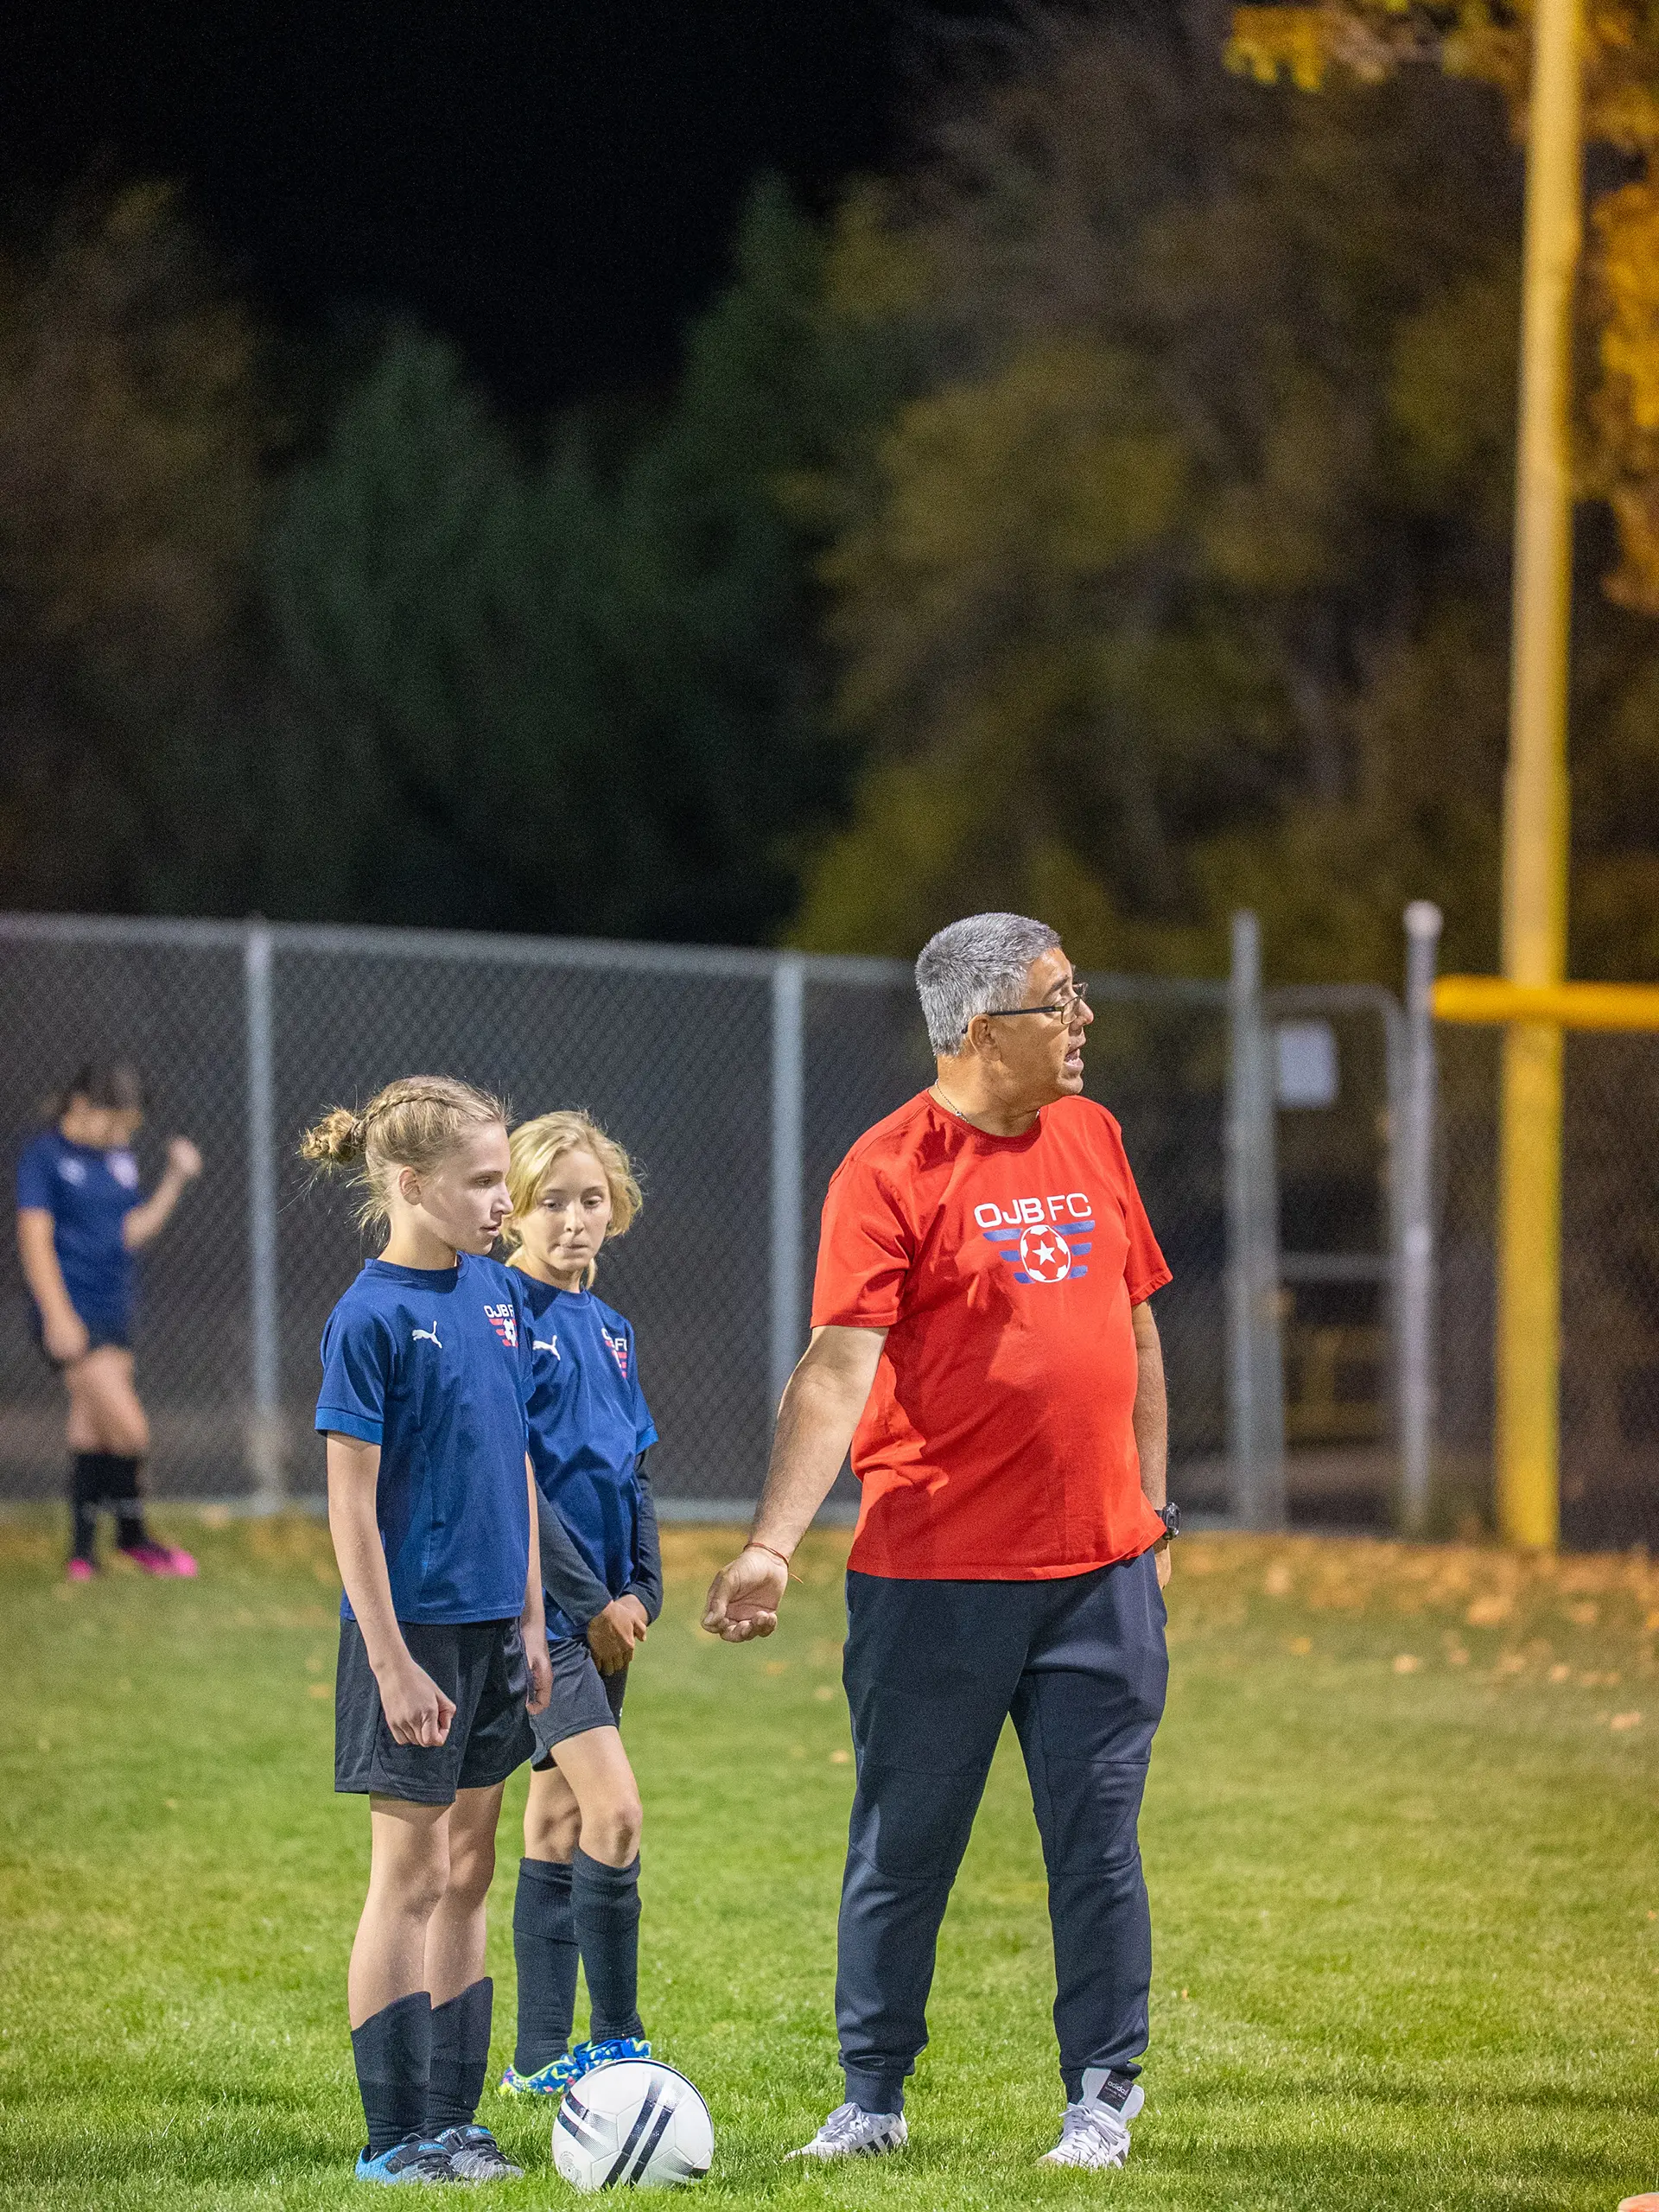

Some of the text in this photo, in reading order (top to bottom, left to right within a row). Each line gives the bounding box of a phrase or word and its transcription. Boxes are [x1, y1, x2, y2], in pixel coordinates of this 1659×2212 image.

[974, 1193, 1092, 1228] OJB FC
[484, 1304, 510, 1318] OJB
